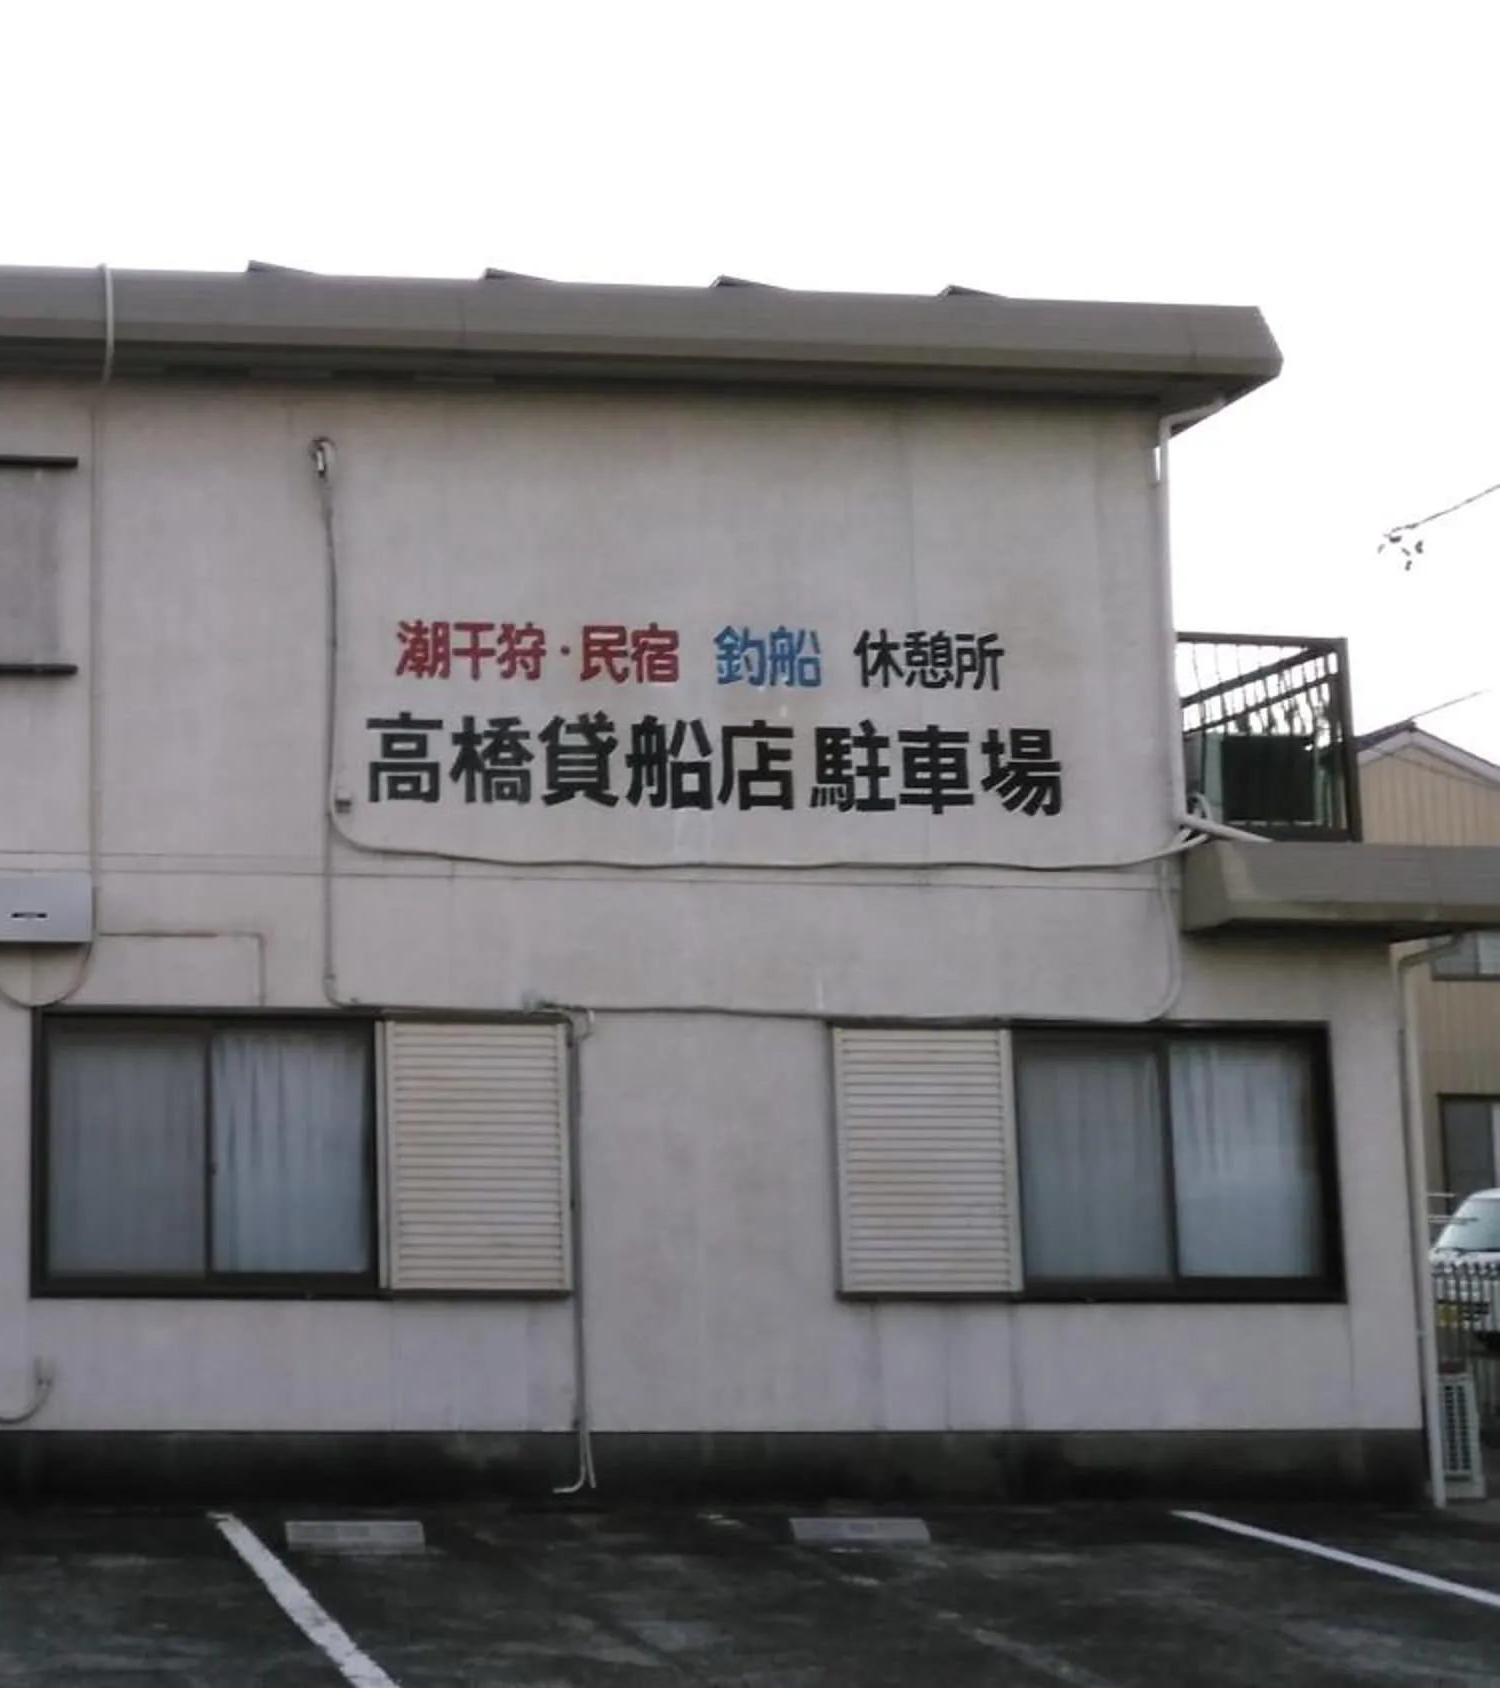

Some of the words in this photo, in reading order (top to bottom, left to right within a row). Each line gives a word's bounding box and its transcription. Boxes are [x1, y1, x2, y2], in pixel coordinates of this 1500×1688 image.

[713, 625, 821, 687] 釣船
[854, 629, 1004, 691] 休憩所
